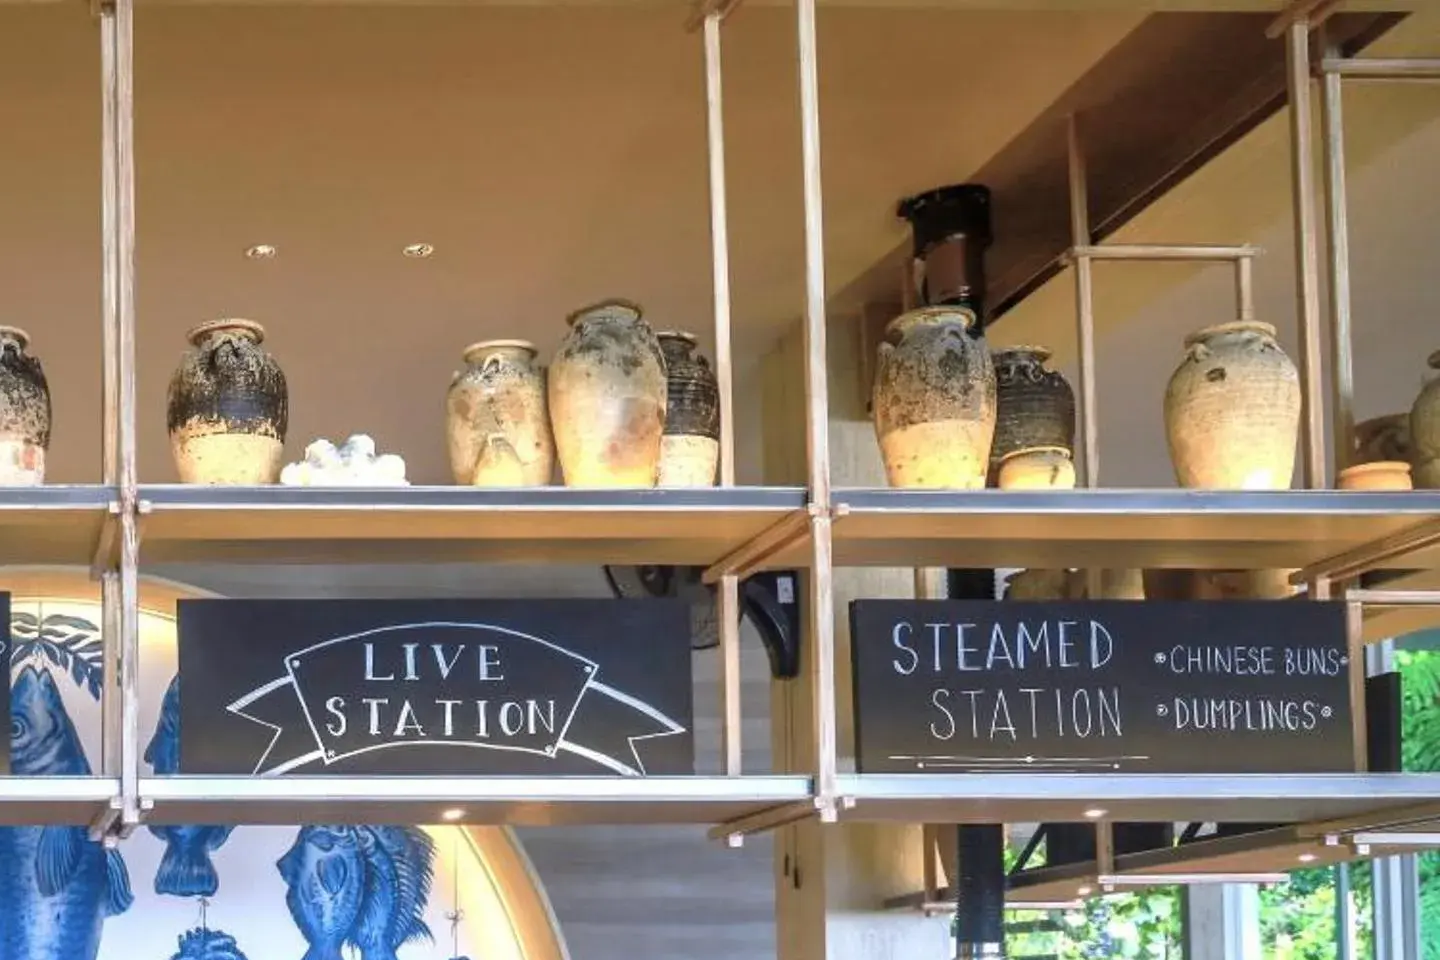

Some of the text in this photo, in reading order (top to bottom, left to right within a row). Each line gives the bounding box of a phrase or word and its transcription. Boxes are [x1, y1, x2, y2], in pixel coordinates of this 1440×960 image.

[364, 642, 505, 681] LIVE
[891, 619, 1114, 676] STEAMED
[1169, 645, 1342, 677] CHINESE BUNS
[325, 696, 557, 738] STATION
[929, 687, 1124, 741] STATION
[1175, 697, 1318, 731] DUMPLINGS
